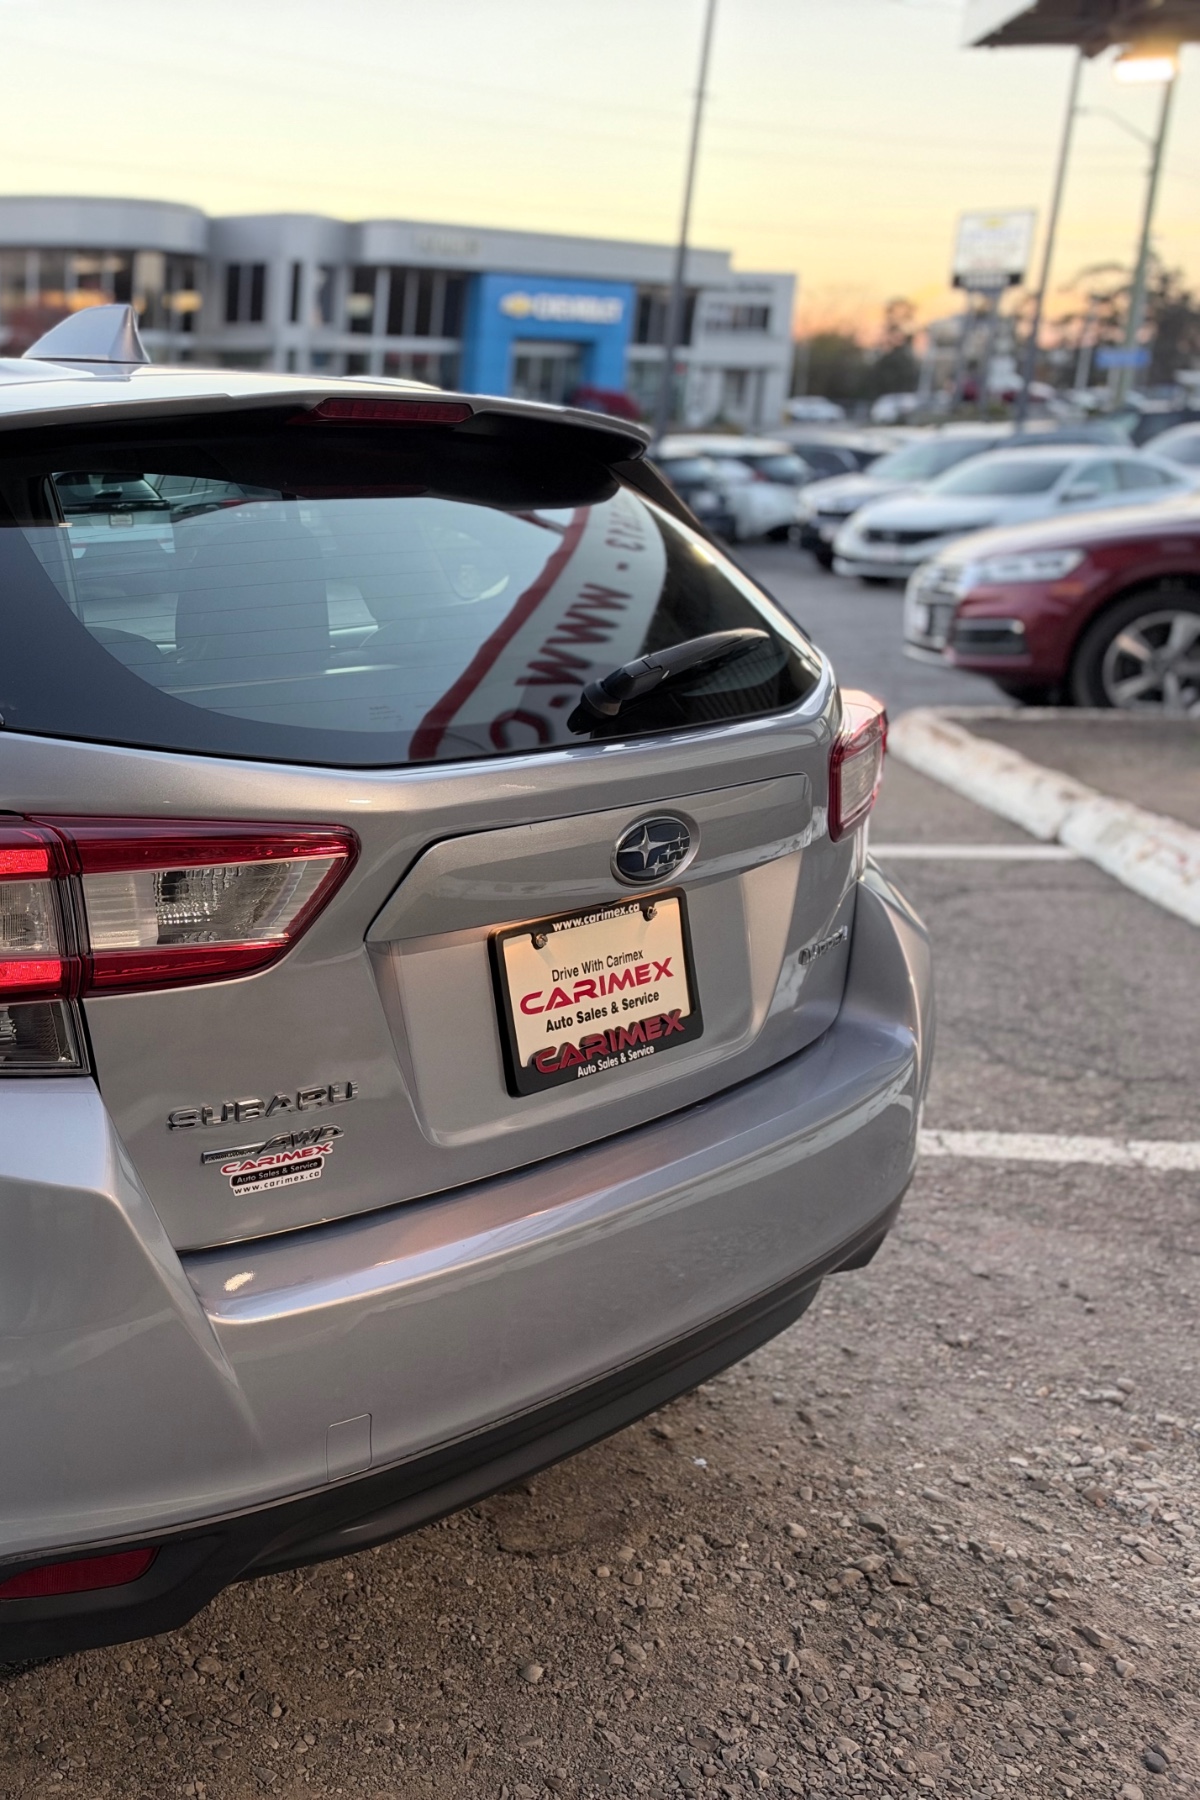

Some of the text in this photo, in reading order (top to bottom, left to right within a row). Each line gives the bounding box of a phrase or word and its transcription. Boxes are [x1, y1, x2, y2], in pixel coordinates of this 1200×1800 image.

[552, 903, 640, 932] www.carimex.ca
[552, 949, 644, 982] Drive With Carimex
[520, 957, 674, 1015] CARIMEX
[546, 991, 660, 1033] Auto Sales & Service
[533, 1008, 685, 1074] CARIMEX
[577, 1044, 655, 1078] Auto Sales & Service
[166, 1079, 359, 1131] SUBARU
[257, 1123, 345, 1154] AWD
[221, 1143, 332, 1174] CARIMEX
[236, 1161, 318, 1184] Auto Sales & Service
[234, 1170, 320, 1195] www.carimex.ca
